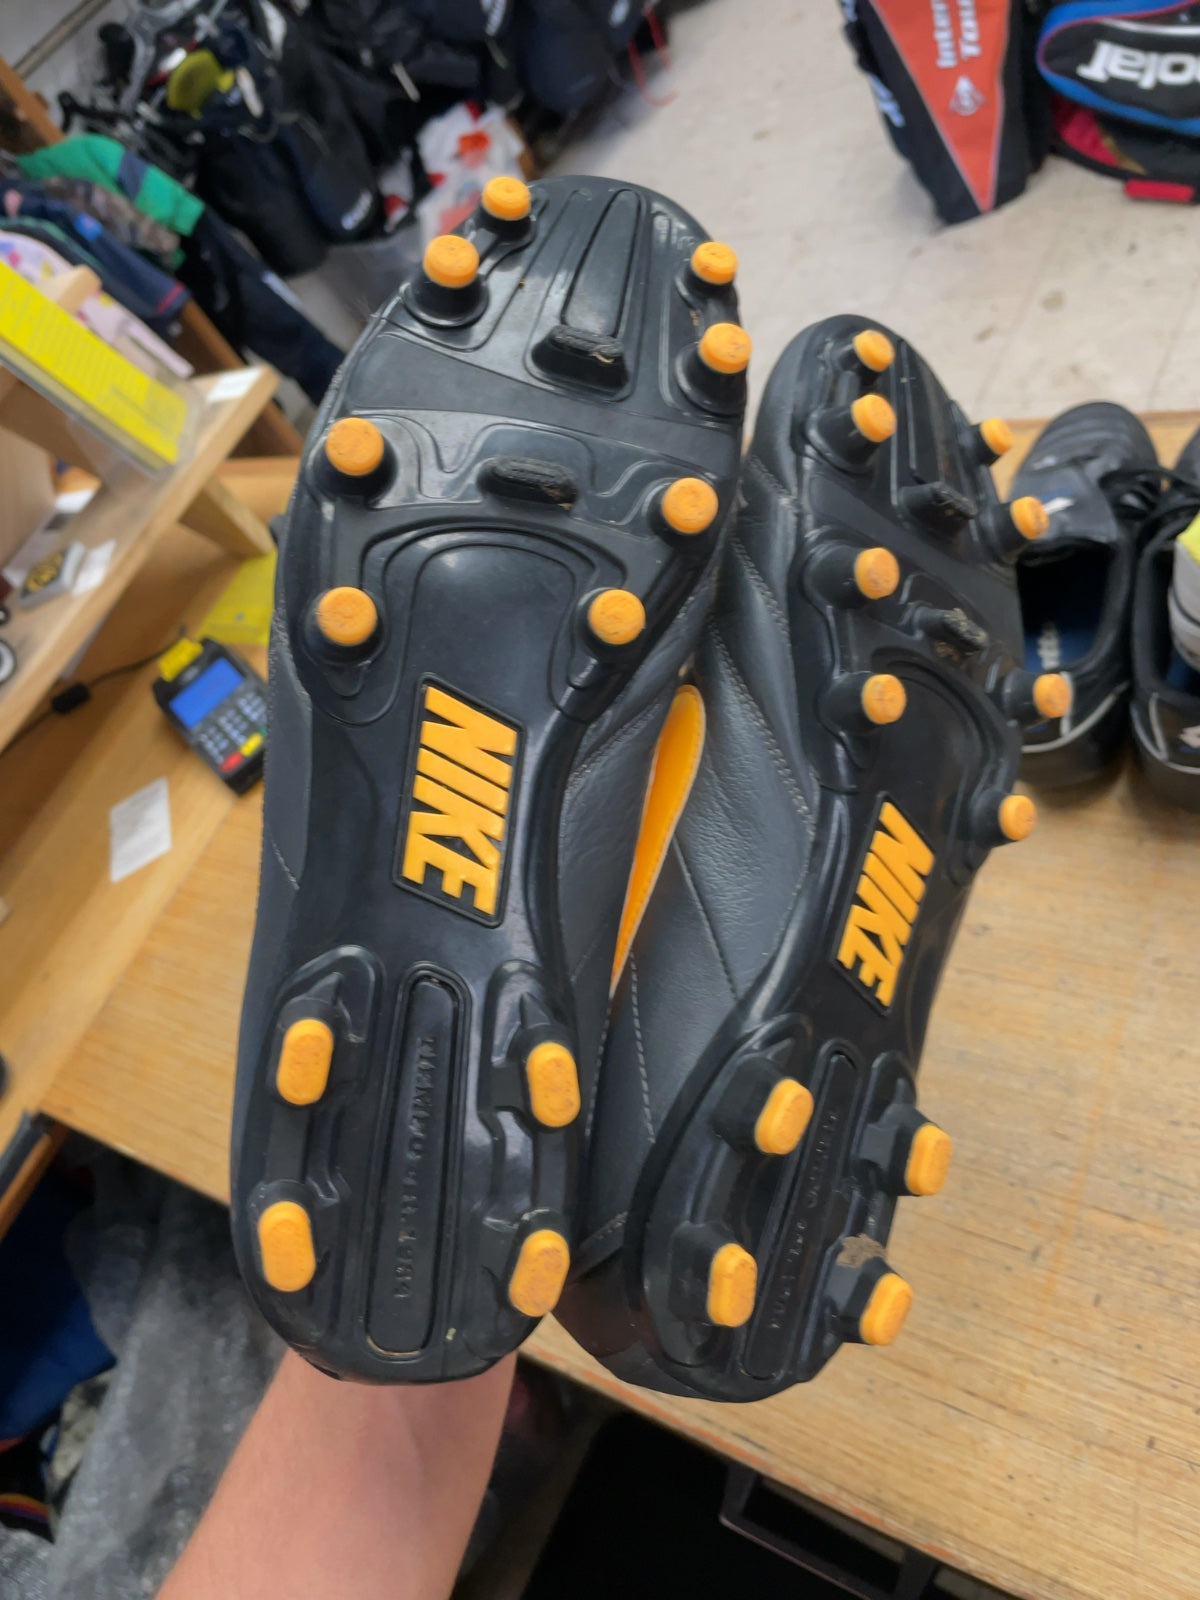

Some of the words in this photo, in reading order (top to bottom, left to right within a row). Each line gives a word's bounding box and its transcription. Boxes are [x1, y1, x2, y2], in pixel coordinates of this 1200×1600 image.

[1076, 40, 1200, 90] olat
[402, 686, 518, 916] NIKE
[837, 802, 935, 1007] NIKE
